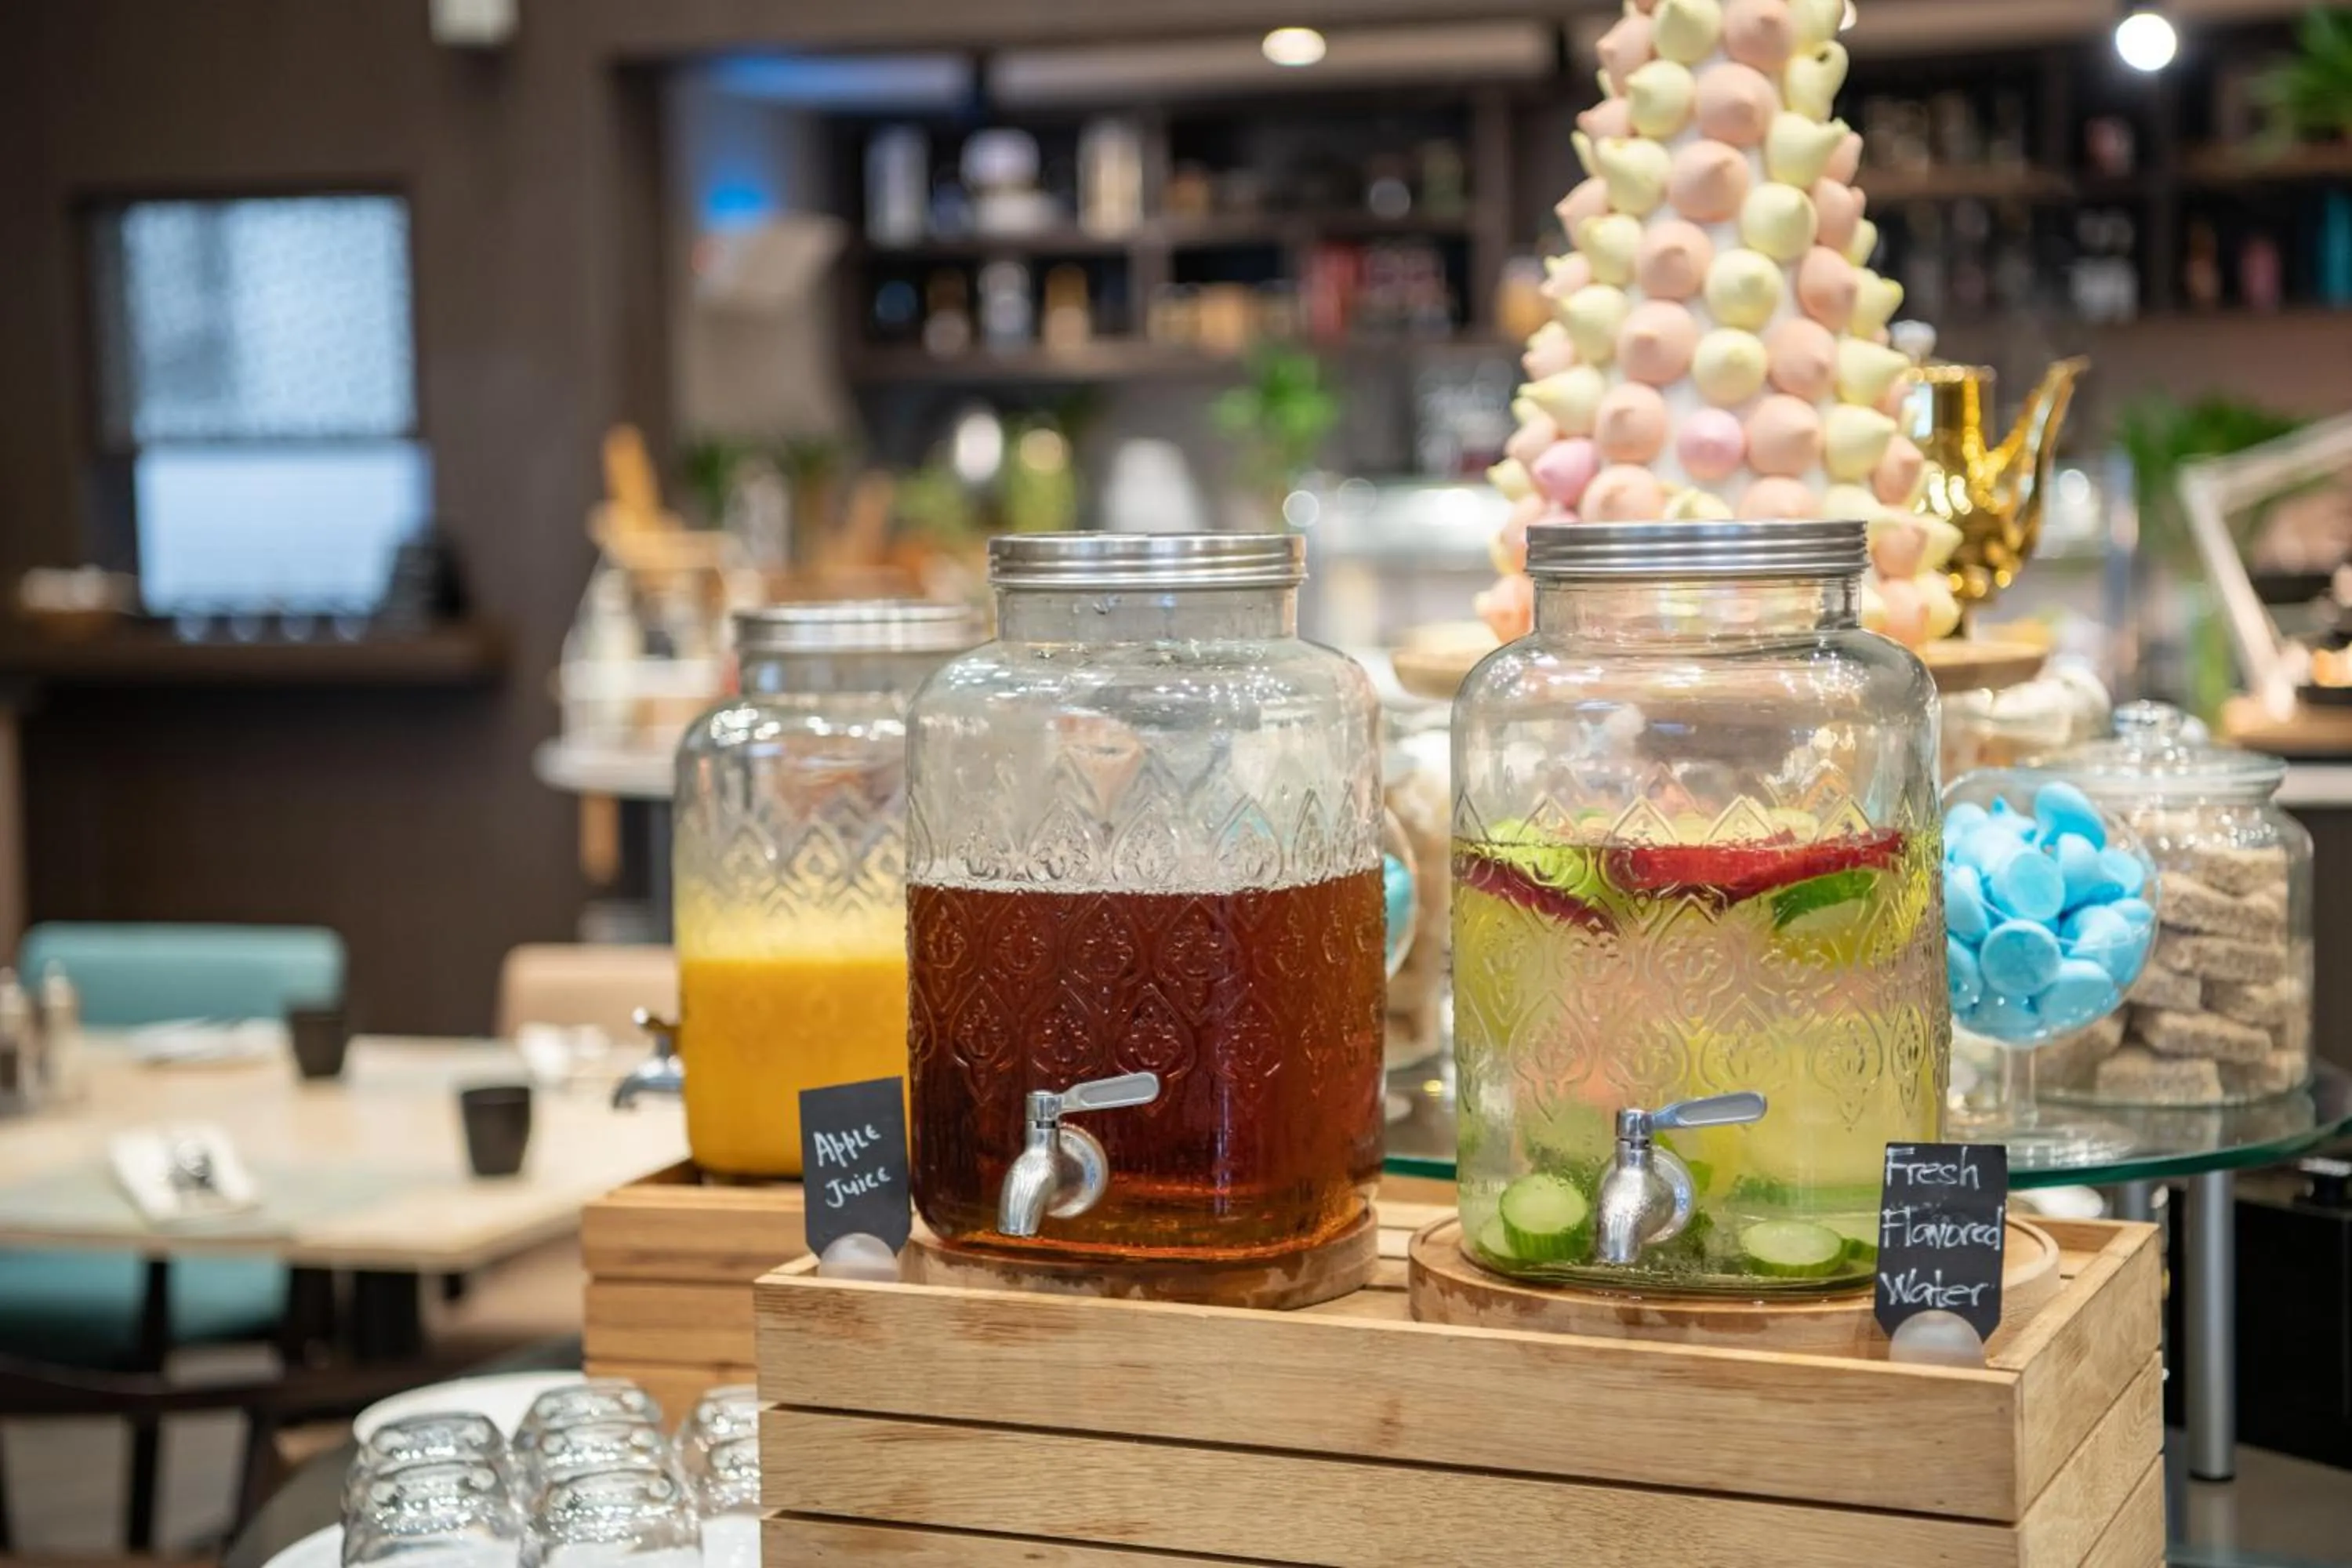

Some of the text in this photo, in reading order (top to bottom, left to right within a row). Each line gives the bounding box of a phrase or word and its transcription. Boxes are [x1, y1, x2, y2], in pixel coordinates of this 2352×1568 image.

[826, 1167, 891, 1208] Juice
[1886, 1145, 1980, 1190] Fresh
[1882, 1205, 2003, 1250] Flavored
[1879, 1268, 1988, 1308] Water
